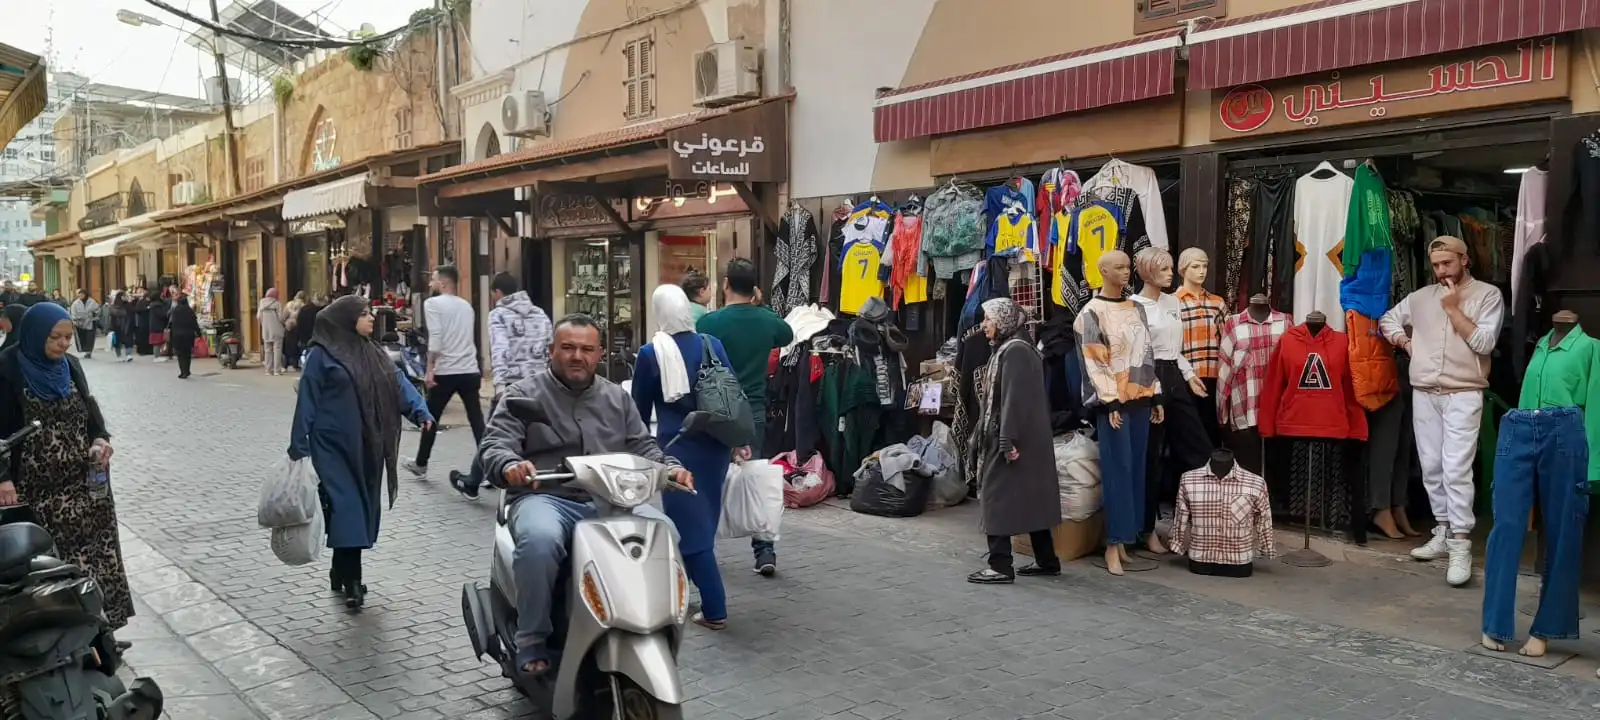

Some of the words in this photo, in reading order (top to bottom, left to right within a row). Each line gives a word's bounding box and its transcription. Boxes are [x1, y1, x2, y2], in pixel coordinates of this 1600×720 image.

[1284, 37, 1556, 126] الحسيني
[673, 132, 765, 158] قرعوني
[691, 161, 750, 175] للساعات
[1091, 224, 1105, 251] 7
[858, 258, 869, 279] 7
